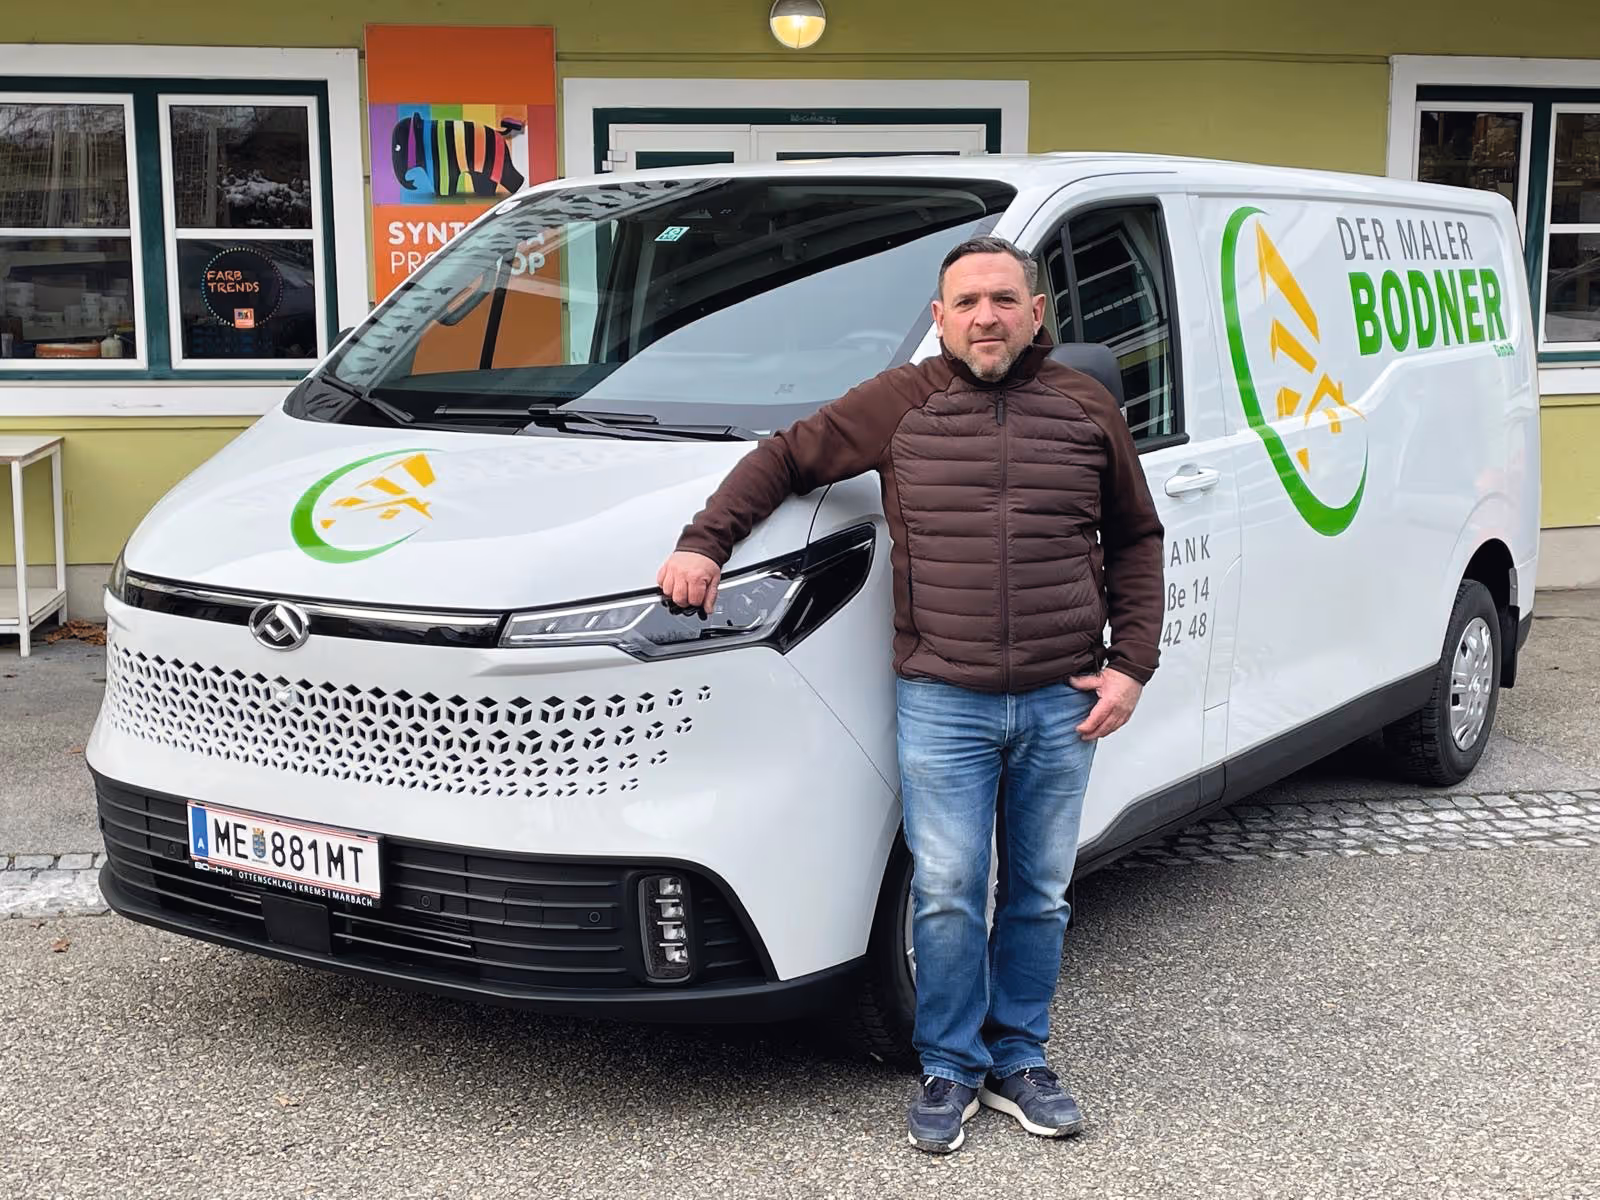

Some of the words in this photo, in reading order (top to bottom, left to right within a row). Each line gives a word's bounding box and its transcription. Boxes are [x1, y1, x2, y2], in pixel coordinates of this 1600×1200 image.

[388, 221, 475, 245] SYNT
[1336, 216, 1391, 261] DER
[1396, 219, 1474, 261] MALER
[206, 270, 243, 282] FARB
[207, 281, 260, 294] TRENDS
[1347, 268, 1508, 357] BODNER
[1162, 534, 1211, 568] ANK
[1166, 582, 1187, 612] ße
[1192, 576, 1210, 604] 14
[1162, 619, 1182, 647] 42
[1188, 612, 1208, 640] 48
[214, 818, 249, 860] ME
[238, 871, 292, 890] OTTENSCHLAG
[299, 884, 326, 897] KREMS
[332, 891, 373, 907] MARBACH
